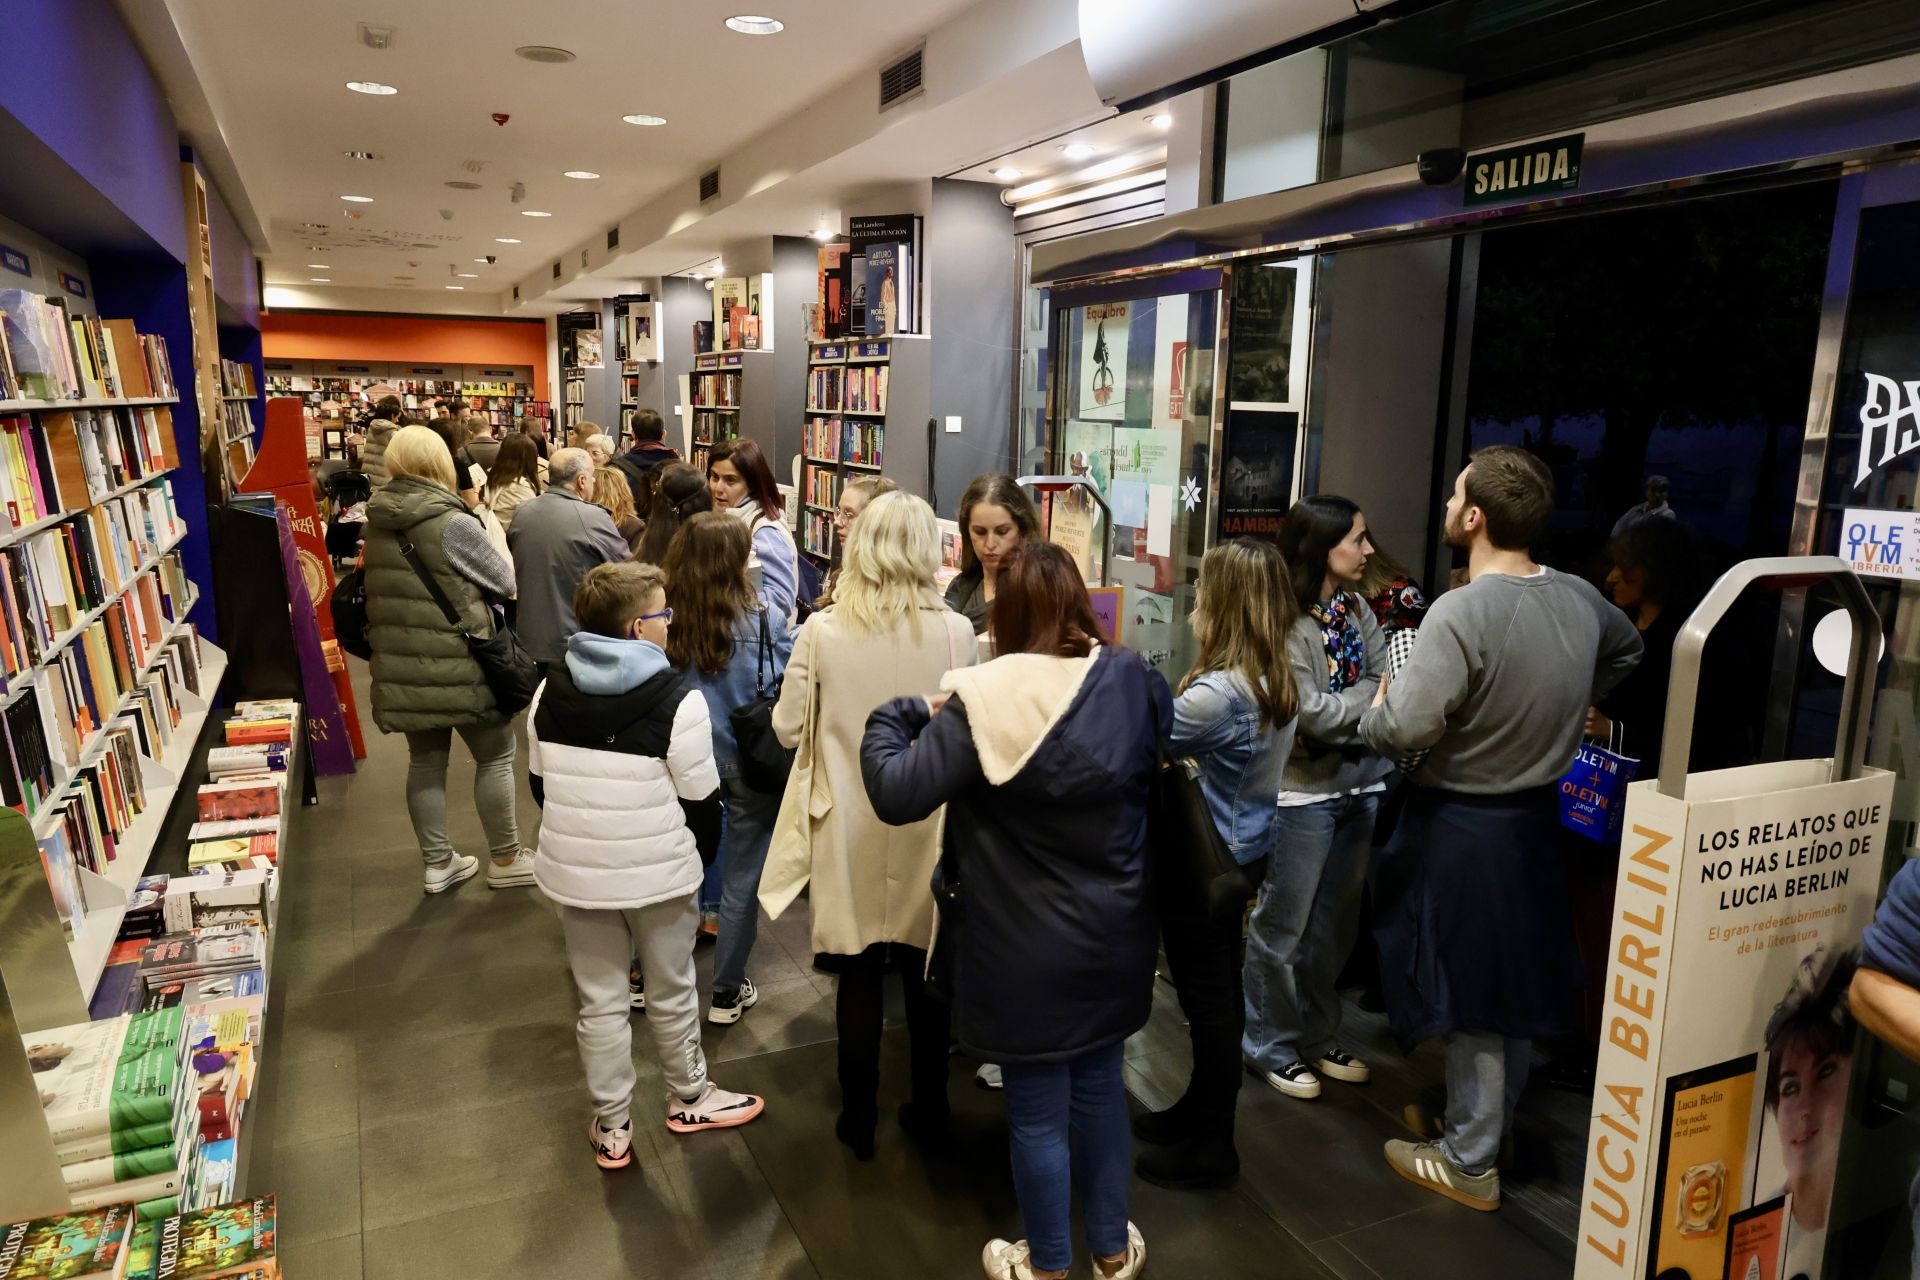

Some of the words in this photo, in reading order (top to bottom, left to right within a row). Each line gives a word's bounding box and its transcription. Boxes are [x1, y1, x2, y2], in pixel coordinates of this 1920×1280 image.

[1474, 148, 1568, 194] SALIDA
[872, 249, 892, 258] ARTURO
[1847, 542, 1902, 565] TVM
[1848, 523, 1904, 546] OLE
[1850, 562, 1903, 574] IBRERÍA
[1698, 829, 1740, 853] LOS
[1748, 813, 1837, 846] RELATOS
[1843, 805, 1881, 829] QUE
[1701, 860, 1732, 883] NO
[1740, 852, 1779, 877] HAS
[1785, 840, 1843, 869] LEÍDO
[1848, 835, 1871, 857] DE
[1719, 883, 1778, 910] LUCIA
[1785, 868, 1849, 897] BERLIN
[1609, 824, 1673, 1061] BERLIN
[1708, 925, 1720, 941] El
[1723, 924, 1749, 942] gran
[1753, 903, 1848, 931] redescubrimiento
[1736, 939, 1751, 955] de
[1755, 937, 1764, 951] la
[1767, 928, 1818, 949] literatura
[1678, 1098, 1697, 1111] Lucia
[1701, 1091, 1723, 1105] Berlin
[1586, 1084, 1643, 1268] LUCIA
[0, 1222, 30, 1280] PROTEGID
[158, 1215, 180, 1279] PROTEGIDA
[182, 1237, 193, 1248] LA
